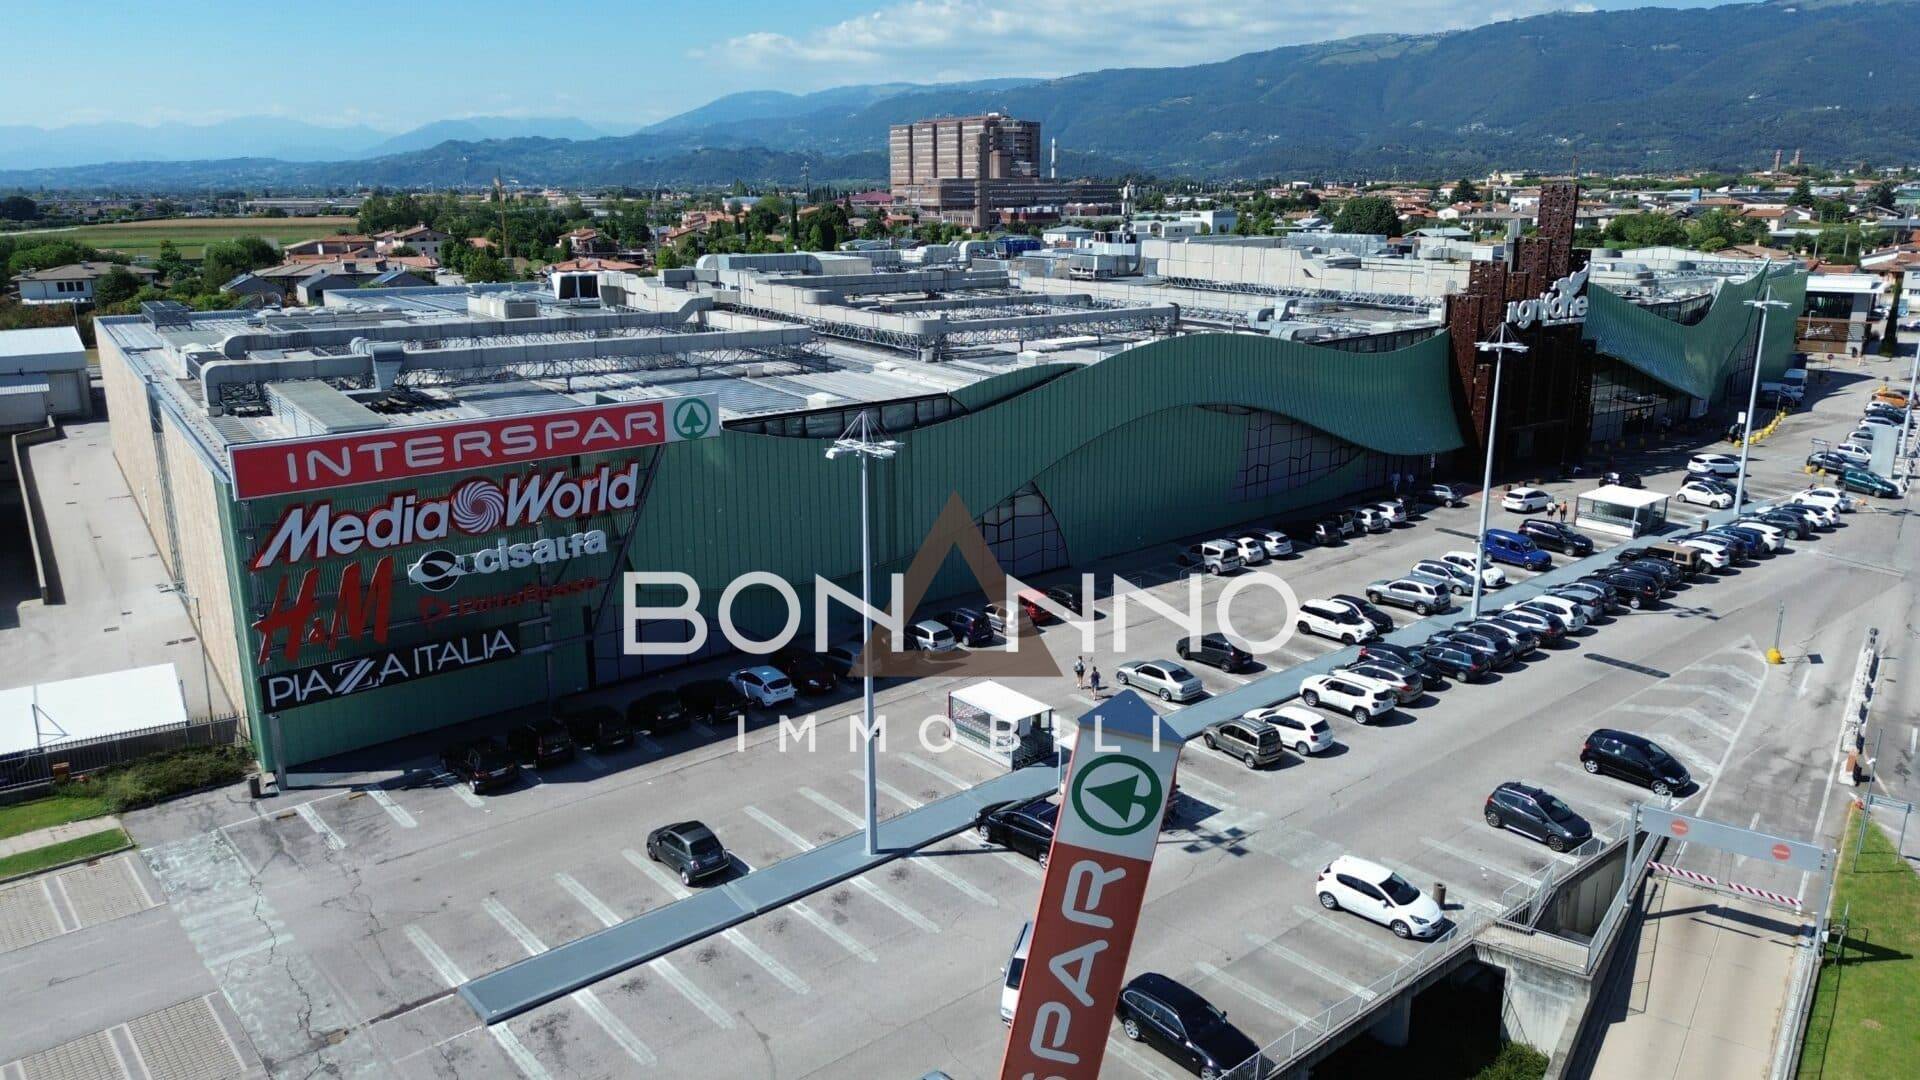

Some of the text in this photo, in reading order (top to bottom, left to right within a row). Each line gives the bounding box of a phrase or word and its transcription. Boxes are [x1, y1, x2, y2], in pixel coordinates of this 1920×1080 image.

[286, 410, 658, 484] INTERSPAR
[475, 529, 608, 574] cisalfa
[251, 555, 394, 666] H&M
[414, 629, 516, 675] ITALIA
[1022, 859, 1127, 1080] PAR
